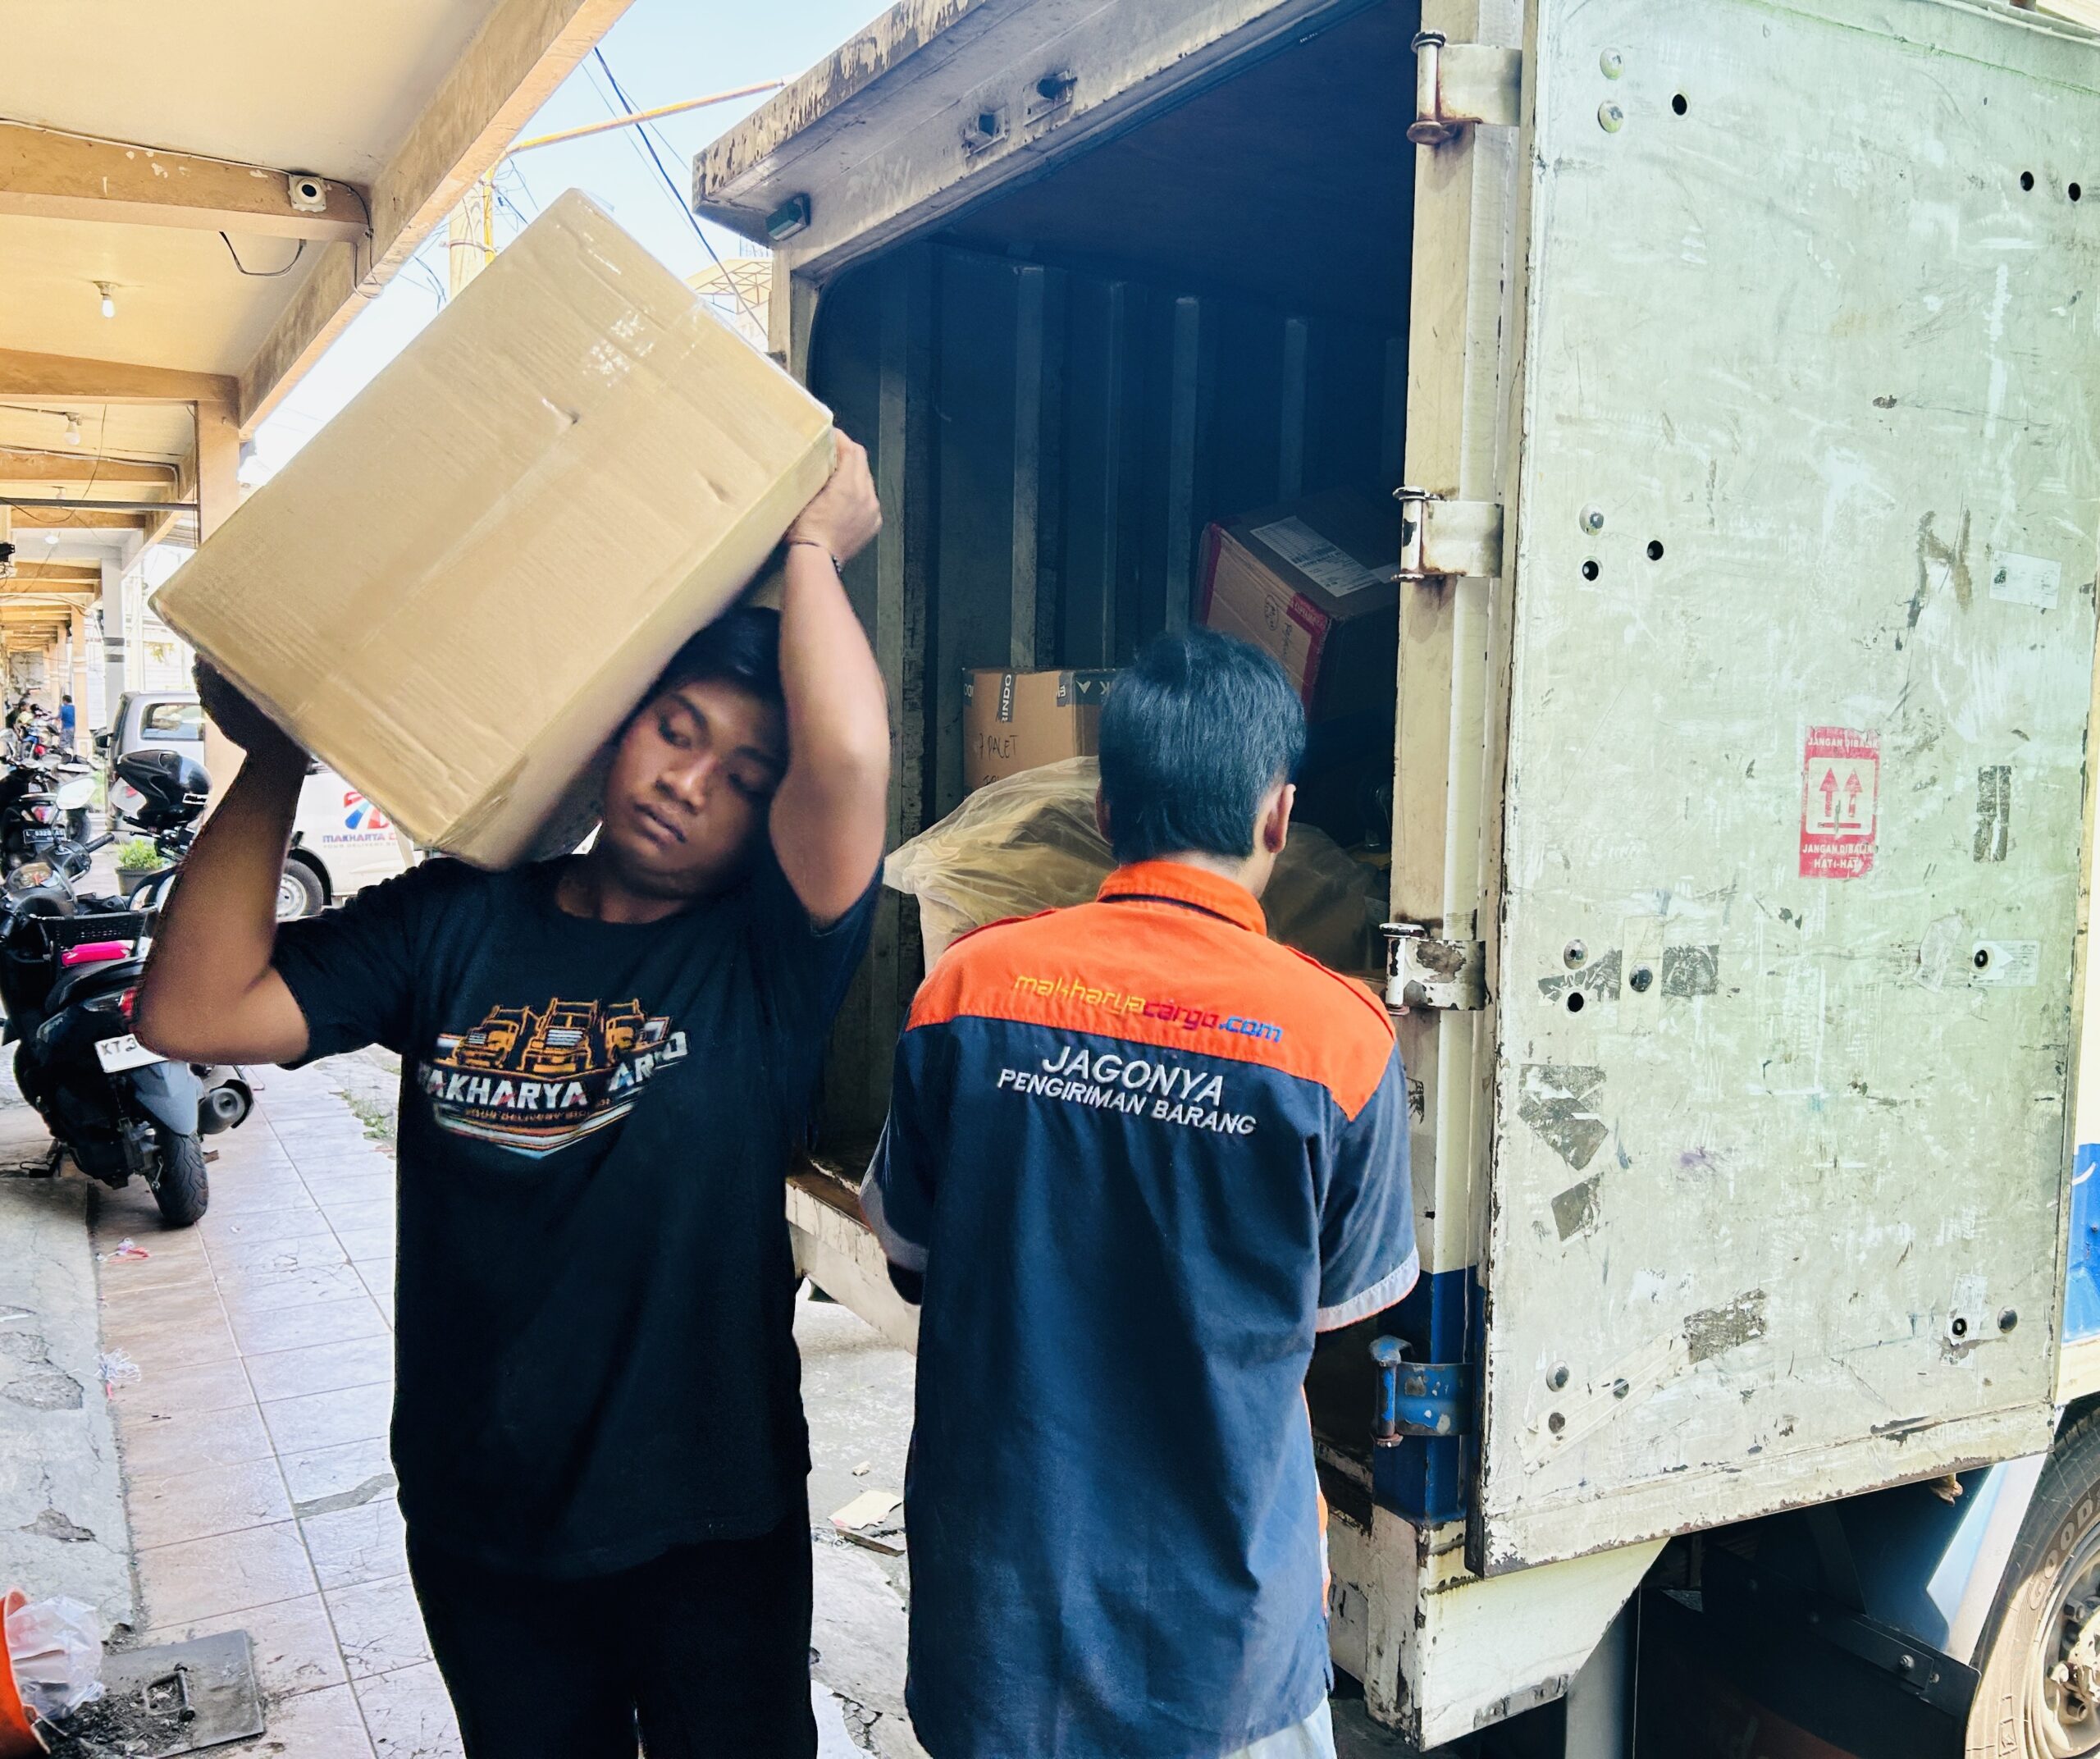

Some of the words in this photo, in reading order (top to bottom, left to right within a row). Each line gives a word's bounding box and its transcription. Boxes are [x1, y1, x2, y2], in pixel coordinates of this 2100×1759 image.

[987, 734, 1019, 761] PALET
[1808, 738, 1843, 747] JANGAN
[1802, 844, 1838, 853] JANGAN
[1839, 843, 1874, 853] DIBALIK
[1042, 1046, 1224, 1106] JAGONYA
[997, 1068, 1147, 1116] PENGIRIMAN
[1151, 1099, 1257, 1135] BARANG
[2029, 1487, 2100, 1610] GOOD
